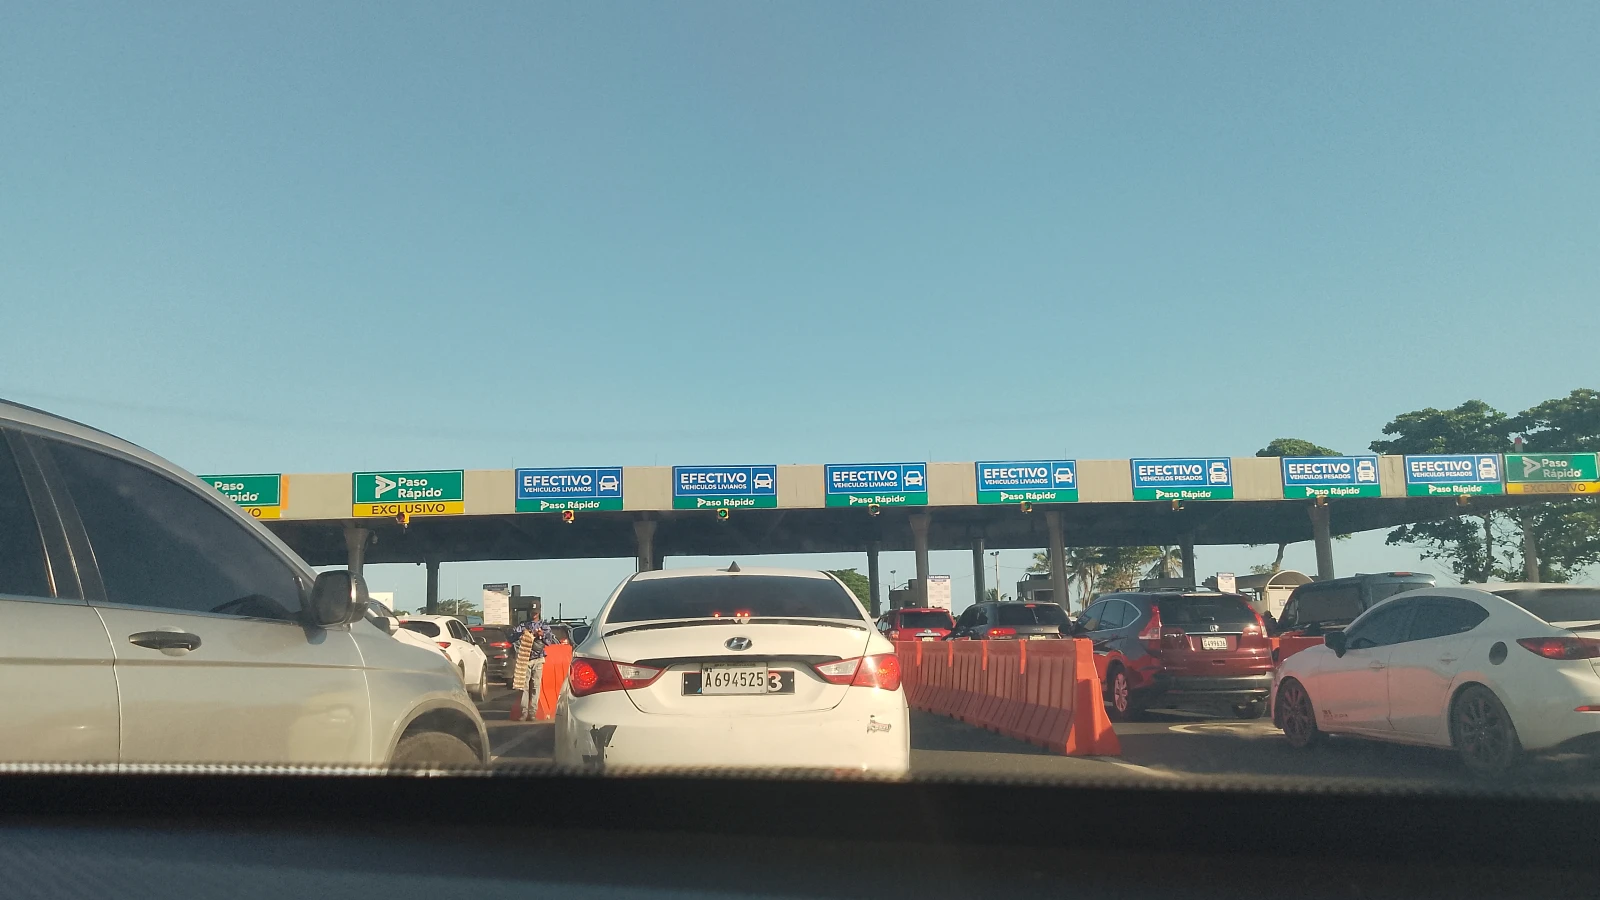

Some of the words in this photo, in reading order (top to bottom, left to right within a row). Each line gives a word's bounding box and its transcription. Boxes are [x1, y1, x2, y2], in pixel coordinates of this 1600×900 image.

[1411, 460, 1471, 471] EFECTIVO
[1542, 458, 1567, 467] Paso
[984, 468, 1047, 479] EFECTIVO
[1138, 465, 1202, 475] EFECTIVO
[1288, 463, 1350, 474] EFECTIVO
[1543, 468, 1582, 479] Rápido
[524, 475, 592, 486] EFECTIVO
[680, 472, 747, 483] EFECTIVO
[833, 470, 897, 481] EFECTIVO
[214, 481, 244, 490] Paso
[398, 477, 428, 487] Paso
[1331, 487, 1360, 496] Rápido
[1453, 484, 1481, 493] Rápido
[1523, 483, 1586, 492] EXCLUSIVO
[398, 488, 442, 500] Rápido
[1026, 492, 1056, 501] Rápido
[1181, 490, 1211, 499] Rápido
[724, 498, 754, 507] Rápido
[875, 495, 905, 504] Rápido
[372, 503, 446, 514] EXCLUSIVO
[568, 501, 600, 510] Rápido
[705, 672, 764, 687] A694525
